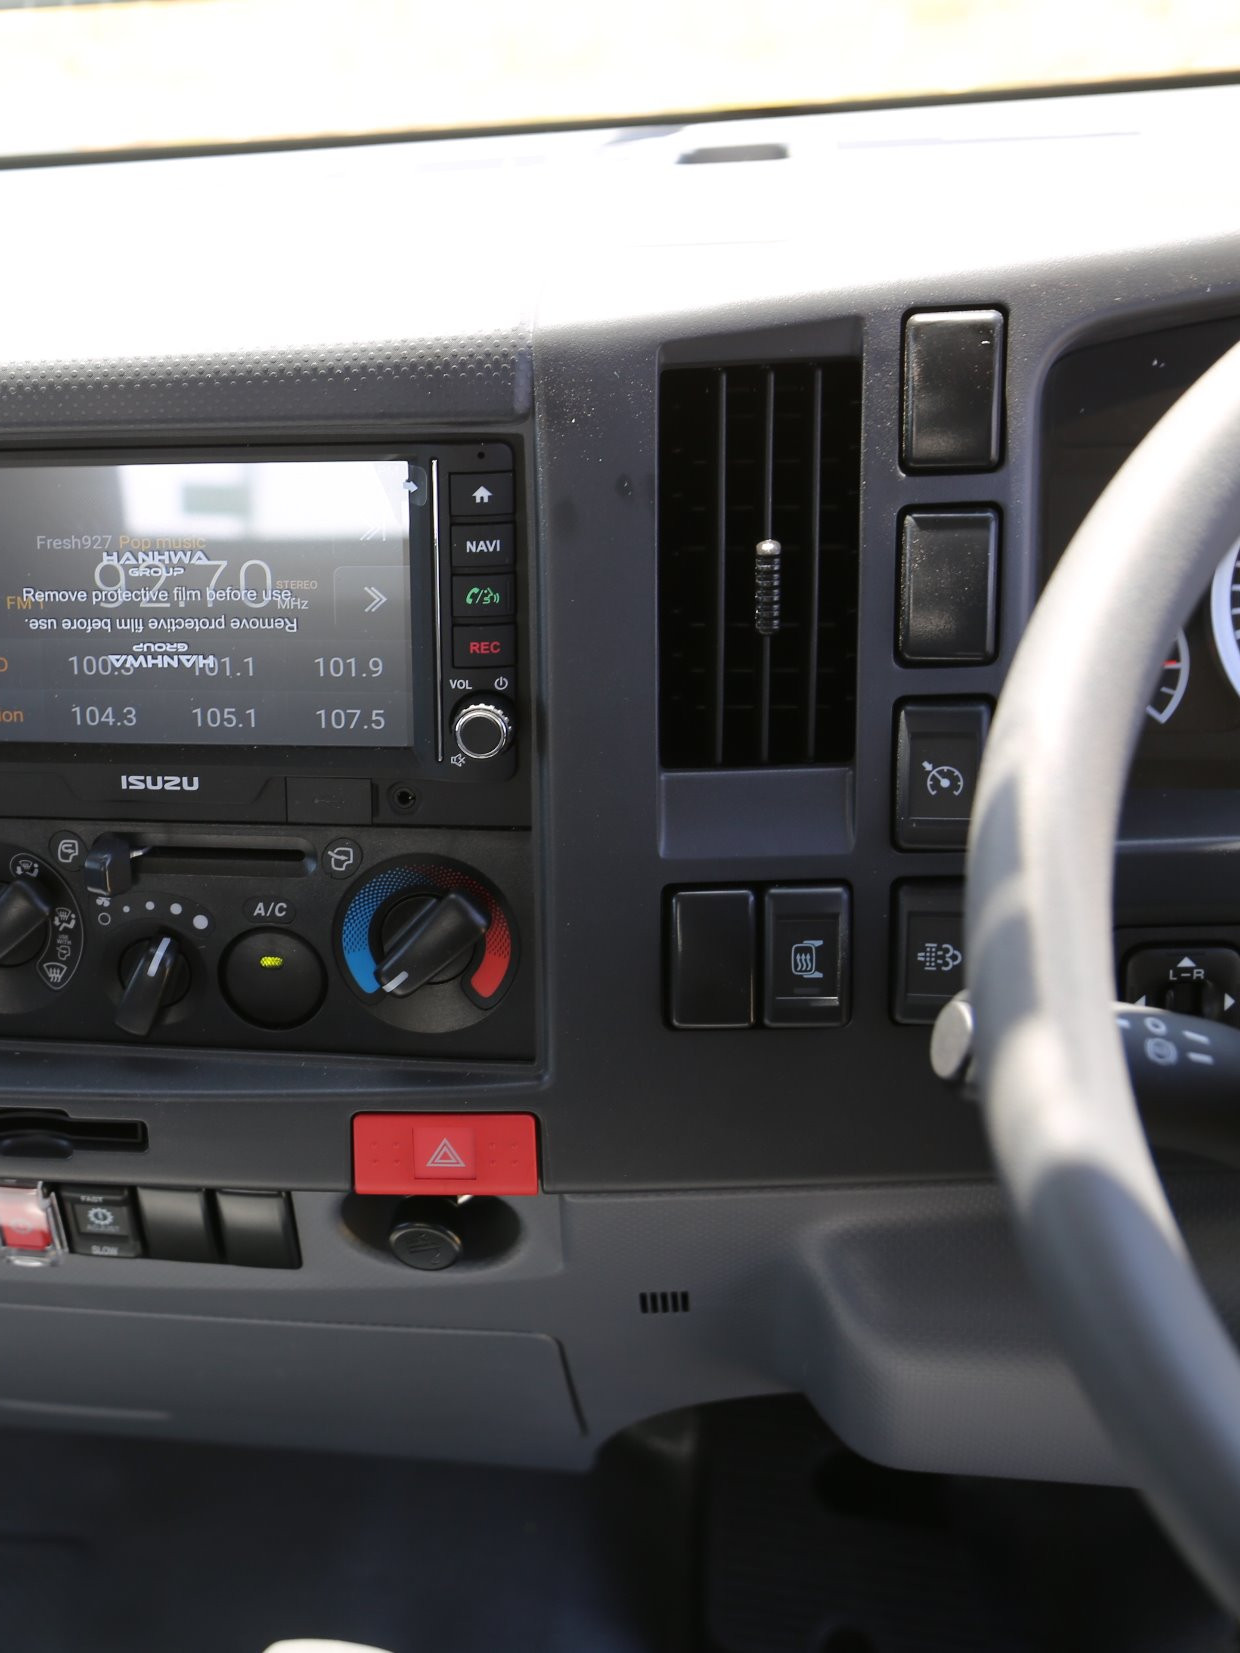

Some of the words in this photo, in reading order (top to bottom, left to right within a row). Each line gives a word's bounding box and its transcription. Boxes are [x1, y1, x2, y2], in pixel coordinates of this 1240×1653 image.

[36, 535, 112, 550] Fresh927
[119, 535, 151, 551] Pop
[156, 537, 206, 549] music
[466, 540, 501, 553] NAVI
[102, 551, 210, 564] HANHWA
[129, 567, 185, 577] GROUP
[94, 559, 272, 609] 92.70
[276, 580, 318, 590] STEREO
[6, 596, 32, 610] FM
[23, 588, 87, 602] Remove
[92, 586, 168, 605] protective
[174, 586, 201, 601] film
[207, 586, 257, 601] before
[262, 589, 296, 602] use.
[277, 599, 309, 610] MHz
[24, 618, 57, 630] use.
[62, 618, 111, 633] before
[116, 618, 144, 633] film
[149, 615, 225, 633] protective
[231, 617, 297, 633] Remove
[132, 643, 189, 652] GROUP
[469, 641, 501, 654] REC
[108, 654, 215, 668] HANHWA
[194, 656, 255, 677] 101.1
[314, 656, 384, 677] 101.9
[449, 679, 473, 690] VOL
[71, 706, 137, 726] 104.3
[192, 707, 256, 728] 105.1
[316, 709, 385, 730] 107.5
[121, 775, 200, 791] ISUZU
[253, 901, 288, 917] A/C
[91, 1244, 119, 1256] SLOW
